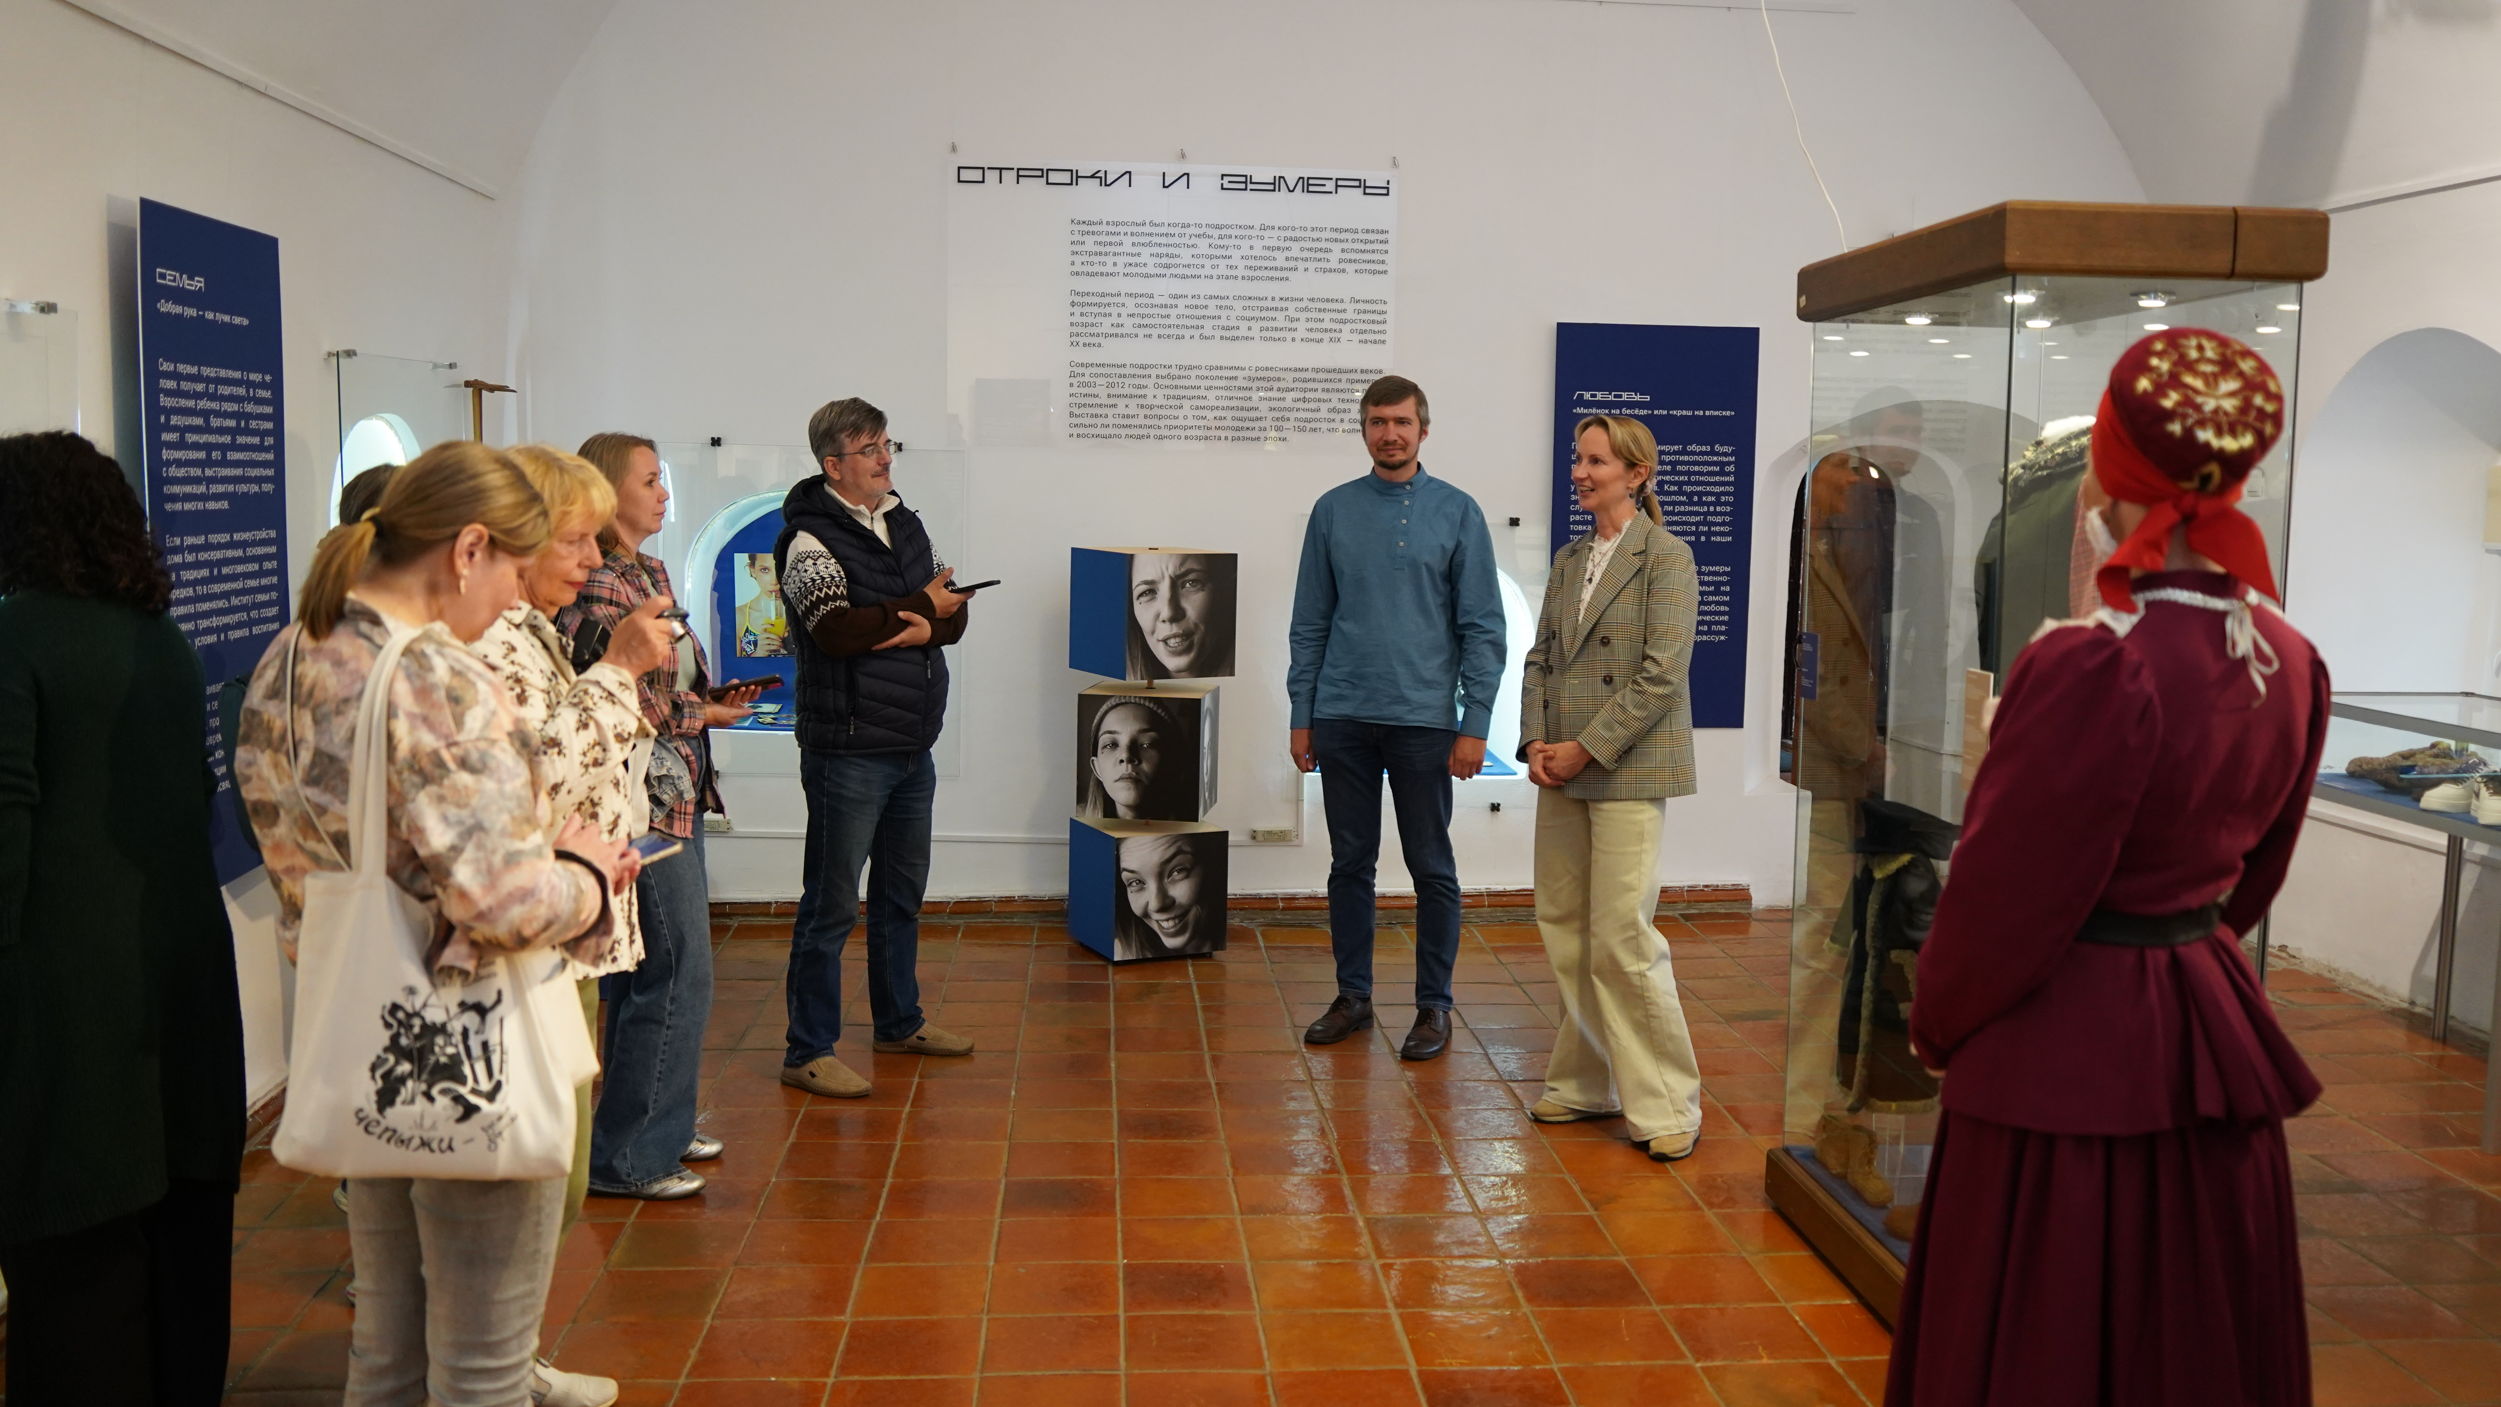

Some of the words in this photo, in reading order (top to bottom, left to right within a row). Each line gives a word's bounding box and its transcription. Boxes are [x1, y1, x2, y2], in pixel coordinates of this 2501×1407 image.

[957, 166, 1132, 188] ОТРОКИ
[1163, 172, 1190, 190] И
[1220, 173, 1390, 196] ЗУМЕРЫ
[1071, 217, 1104, 228] Каждый
[1106, 219, 1147, 229] взрослый
[1149, 220, 1166, 228] был
[1168, 222, 1203, 230] когда-то
[1205, 223, 1257, 232] подростком.
[1259, 223, 1276, 233] Для
[1278, 225, 1308, 233] кого-то
[1330, 227, 1359, 236] период
[1078, 230, 1122, 238] тревогами
[1130, 231, 1176, 239] волнением
[1189, 231, 1216, 242] учебы,
[1218, 234, 1233, 242] для
[1235, 234, 1265, 242] кого-то
[1284, 235, 1323, 244] радостью
[1325, 236, 1350, 244] новых
[1351, 236, 1389, 247] открытий
[1071, 239, 1086, 247] или
[1094, 239, 1124, 249] первой
[1132, 240, 1200, 250] влюбленностью.
[1209, 242, 1242, 252] Кому-то
[1262, 245, 1293, 254] первую
[1300, 246, 1334, 255] очередь
[1341, 247, 1389, 255] вспомнятся
[1071, 250, 1142, 259] экстравагантные
[1150, 252, 1183, 261] наряды,
[1192, 253, 1233, 262] которыми
[1241, 254, 1278, 262] хотелось
[1285, 255, 1331, 263] впечатлить
[1339, 257, 1388, 266] ровесников,
[1124, 261, 1148, 270] ужасе
[1154, 262, 1205, 271] содрогнется
[1244, 264, 1299, 274] переживаний
[1314, 266, 1349, 276] страхов,
[1355, 268, 1389, 277] которые
[156, 268, 205, 293] СЕМЬЯ
[1070, 270, 1120, 279] овладевают
[1123, 271, 1167, 280] молодыми
[1169, 272, 1202, 281] людьми
[1241, 274, 1292, 283] взросления.
[1070, 289, 1122, 300] Переходный
[1125, 292, 1155, 301] период
[1169, 293, 1189, 302] один
[1307, 296, 1346, 304] человека.
[1349, 296, 1388, 305] Личность
[1070, 299, 1128, 310] формируется,
[1135, 302, 1179, 310] осознавая
[1185, 303, 1209, 311] новое
[1216, 304, 1236, 313] тело,
[1242, 305, 1289, 314] отстраивая
[1295, 304, 1348, 314] собственные
[1354, 307, 1388, 316] границы
[1070, 321, 1103, 330] возраст
[1132, 322, 1205, 330] самостоятельная
[1212, 324, 1240, 332] стадия
[1260, 325, 1298, 334] развитии
[1305, 326, 1343, 334] человека
[1350, 327, 1387, 336] отдельно
[1070, 360, 1128, 371] Современные
[1130, 363, 1173, 372] подростки
[1175, 364, 1203, 373] трудно
[1205, 364, 1247, 373] сравнимы
[1255, 365, 1310, 374] ровесниками
[1311, 366, 1359, 375] прошедших
[1360, 367, 1386, 375] веков.
[1573, 391, 1650, 401] ЛЮБОВЬ
[1686, 442, 1711, 453] образ
[1714, 442, 1736, 453] буду-
[1661, 454, 1736, 463] противоположным
[1676, 464, 1720, 473] поговорим
[1724, 462, 1735, 471] об
[1690, 472, 1735, 481] отношений
[1664, 482, 1679, 491] Как
[1682, 484, 1735, 493] происходило
[1674, 504, 1708, 513] разница
[1570, 514, 1593, 523] расте
[1707, 515, 1733, 523] подго-
[1701, 565, 1731, 574] зумеры
[1699, 602, 1730, 611] любовь
